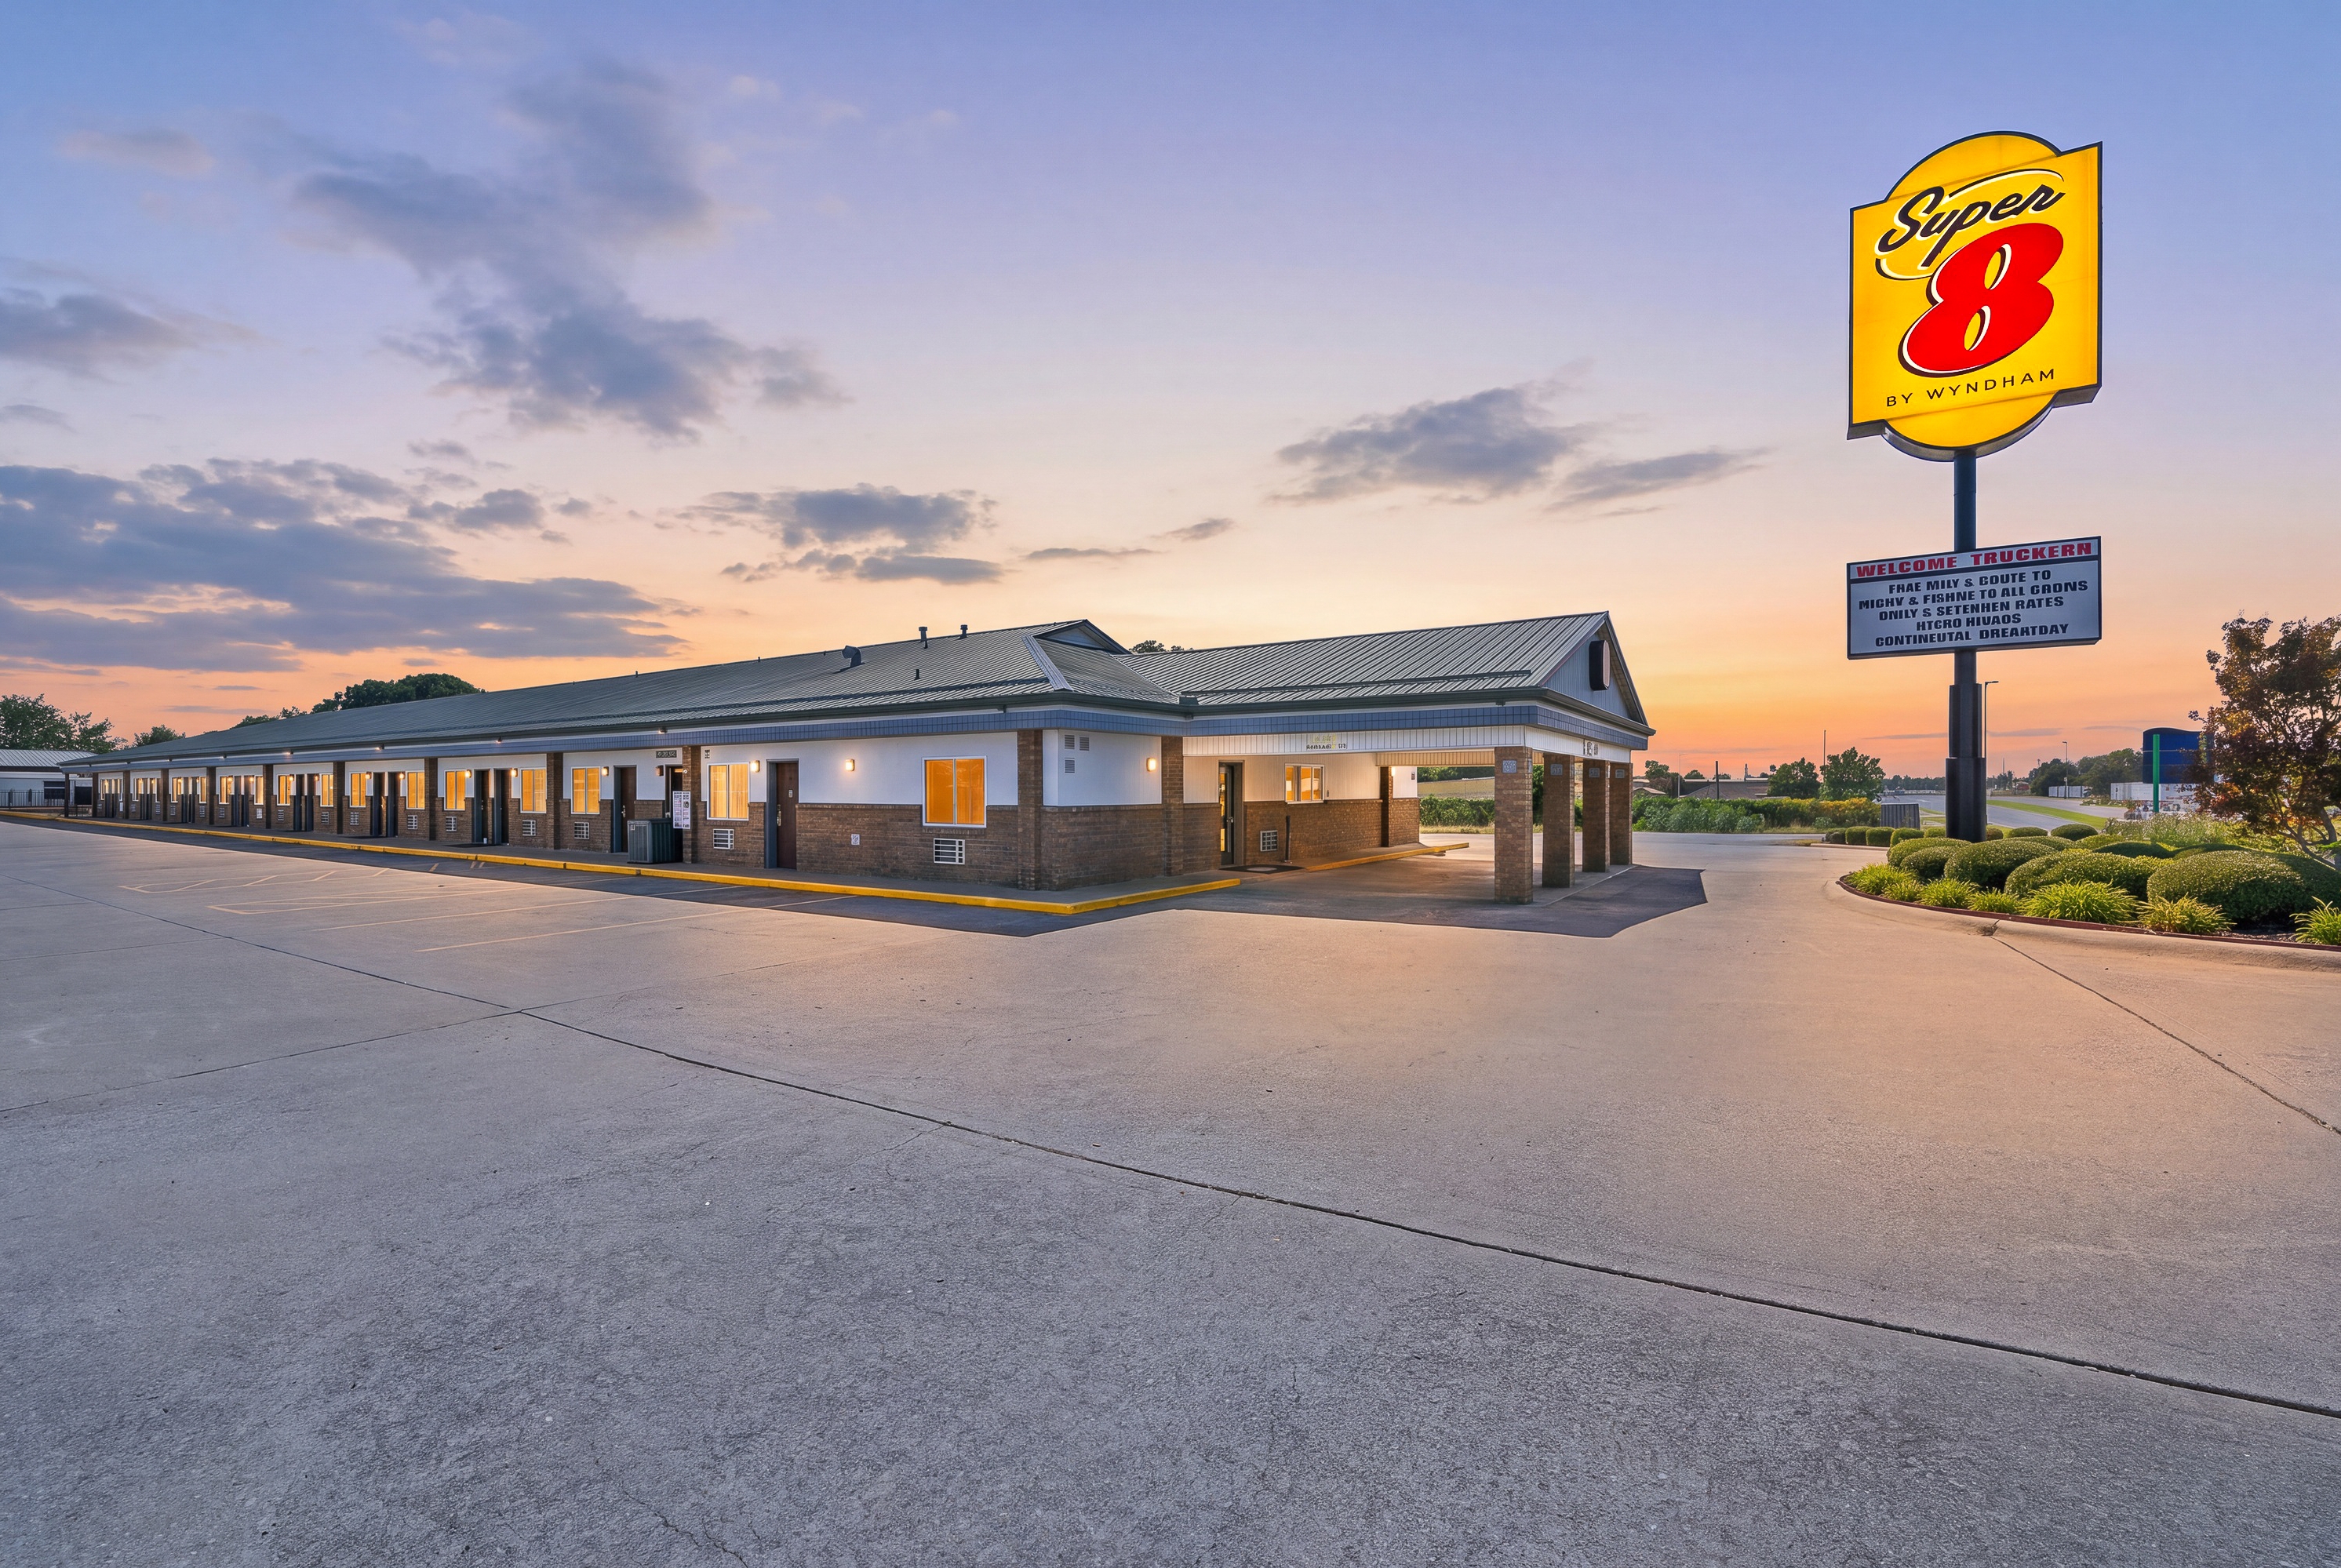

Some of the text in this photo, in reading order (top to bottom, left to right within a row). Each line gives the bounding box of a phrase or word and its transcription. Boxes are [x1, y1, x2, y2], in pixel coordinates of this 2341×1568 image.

[1877, 184, 2066, 268] Super
[1899, 222, 2064, 378] 8
[1886, 368, 2055, 407] BY WYNDHAM
[1856, 542, 2092, 578] WELCOME TRUCKERN
[2032, 569, 2052, 581] TO
[1908, 596, 1919, 606] &
[1979, 588, 1997, 599] TO
[2001, 586, 2026, 598] ALL
[2015, 595, 2064, 610] RATES
